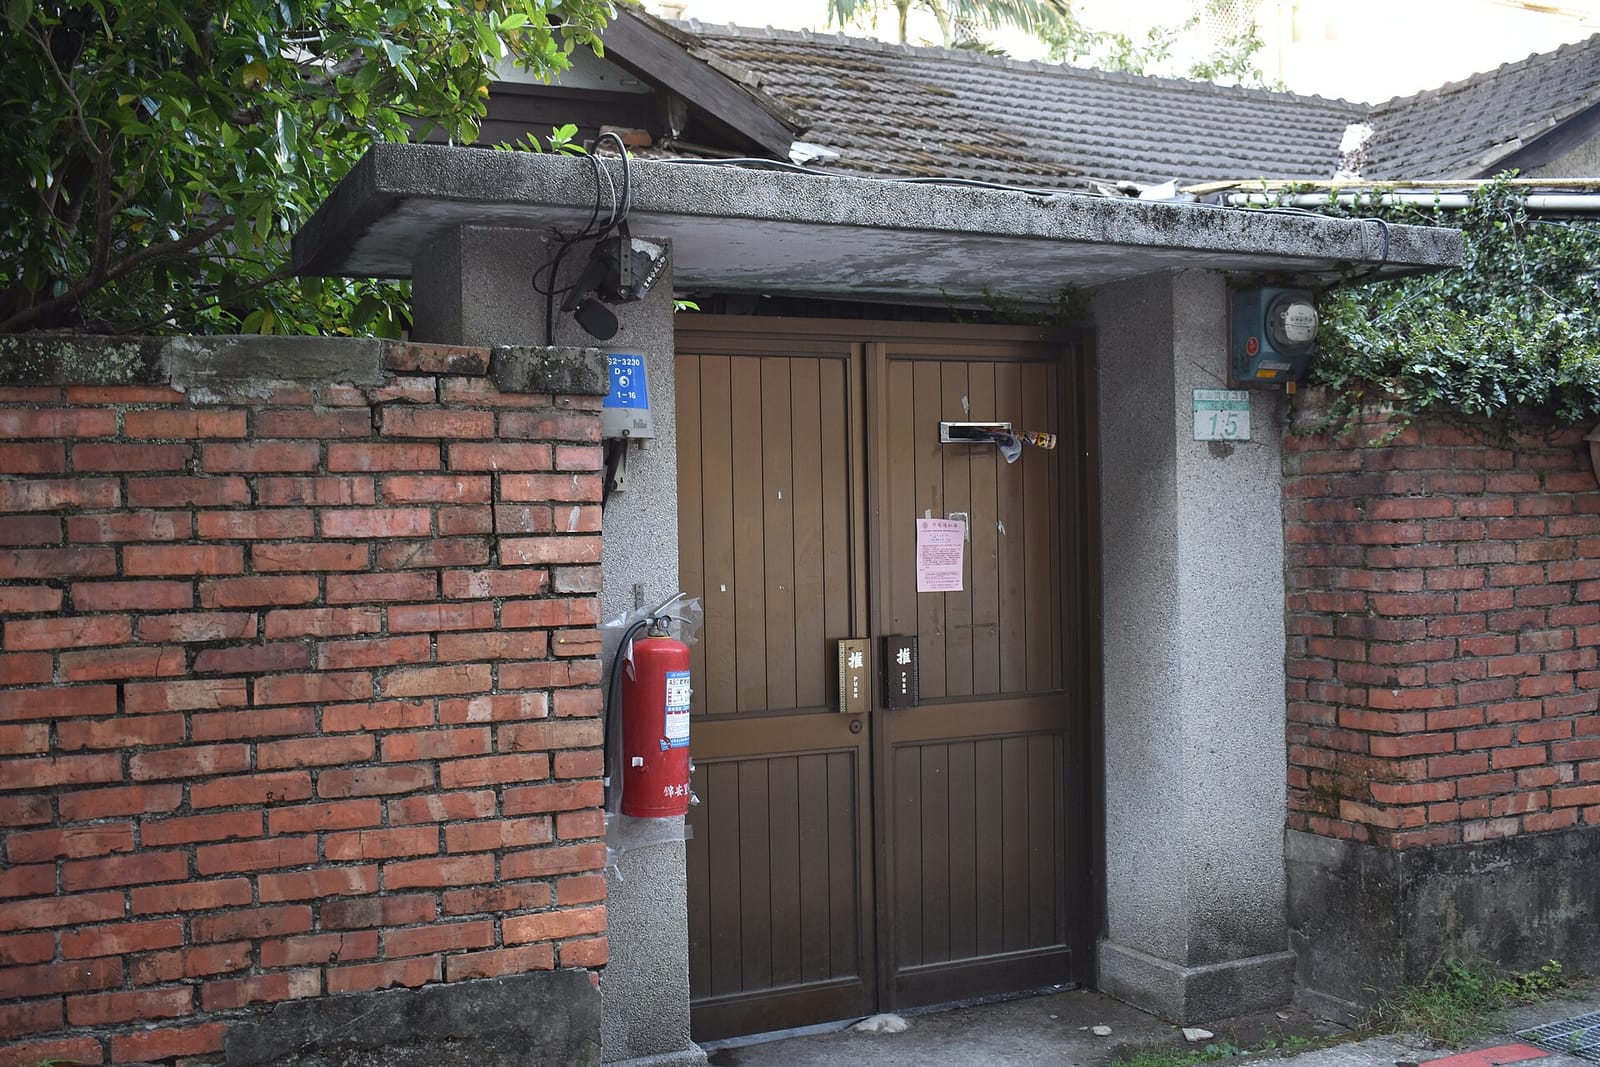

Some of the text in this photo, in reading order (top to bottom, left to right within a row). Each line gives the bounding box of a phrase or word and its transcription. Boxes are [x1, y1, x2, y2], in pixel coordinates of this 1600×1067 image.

[617, 391, 637, 399] 1-16
[1209, 413, 1238, 436] 15
[848, 651, 864, 669] 推
[896, 647, 912, 665] 推
